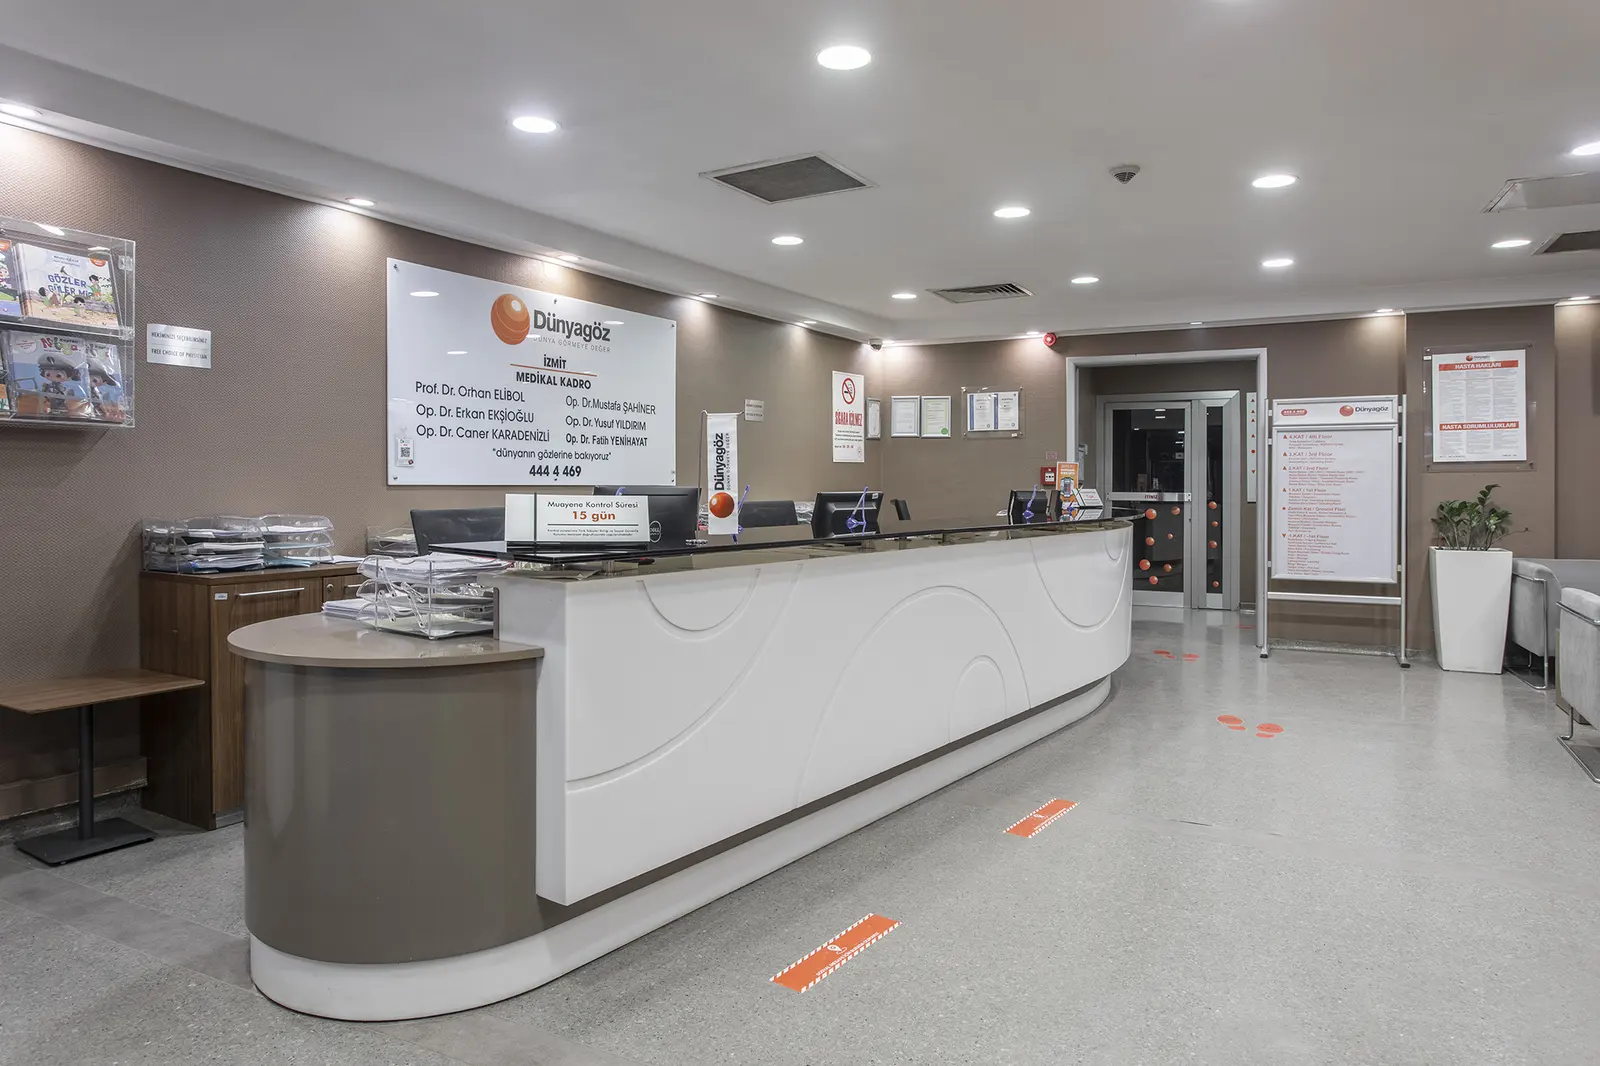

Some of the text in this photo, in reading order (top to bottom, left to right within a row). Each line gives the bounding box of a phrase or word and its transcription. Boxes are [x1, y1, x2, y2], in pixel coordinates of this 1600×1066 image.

[48, 273, 86, 288] GÖZLER
[534, 309, 610, 342] Dünyagöz
[544, 354, 566, 369] İZMİT
[516, 371, 592, 389] MEDİKAL KADRO
[416, 381, 526, 402] Prof. Dr. Orhan ELİBOL
[566, 395, 580, 409] Op.
[622, 402, 656, 414] ŞAHİNER
[416, 404, 534, 423] Op. Dr. Erkan EKŞİOĞLU
[565, 416, 646, 430] Op. Dr. Yusuf YILDIRIM
[416, 424, 550, 442] Op. Dr. Caner KARADENİZLİ
[566, 433, 648, 446] Op. Dr. Fatih YENİHAYAT
[537, 450, 573, 460] gözlerine
[714, 432, 726, 490] Dünyagöz
[529, 465, 582, 477] 444 4 469
[573, 511, 616, 522] 15 gün
